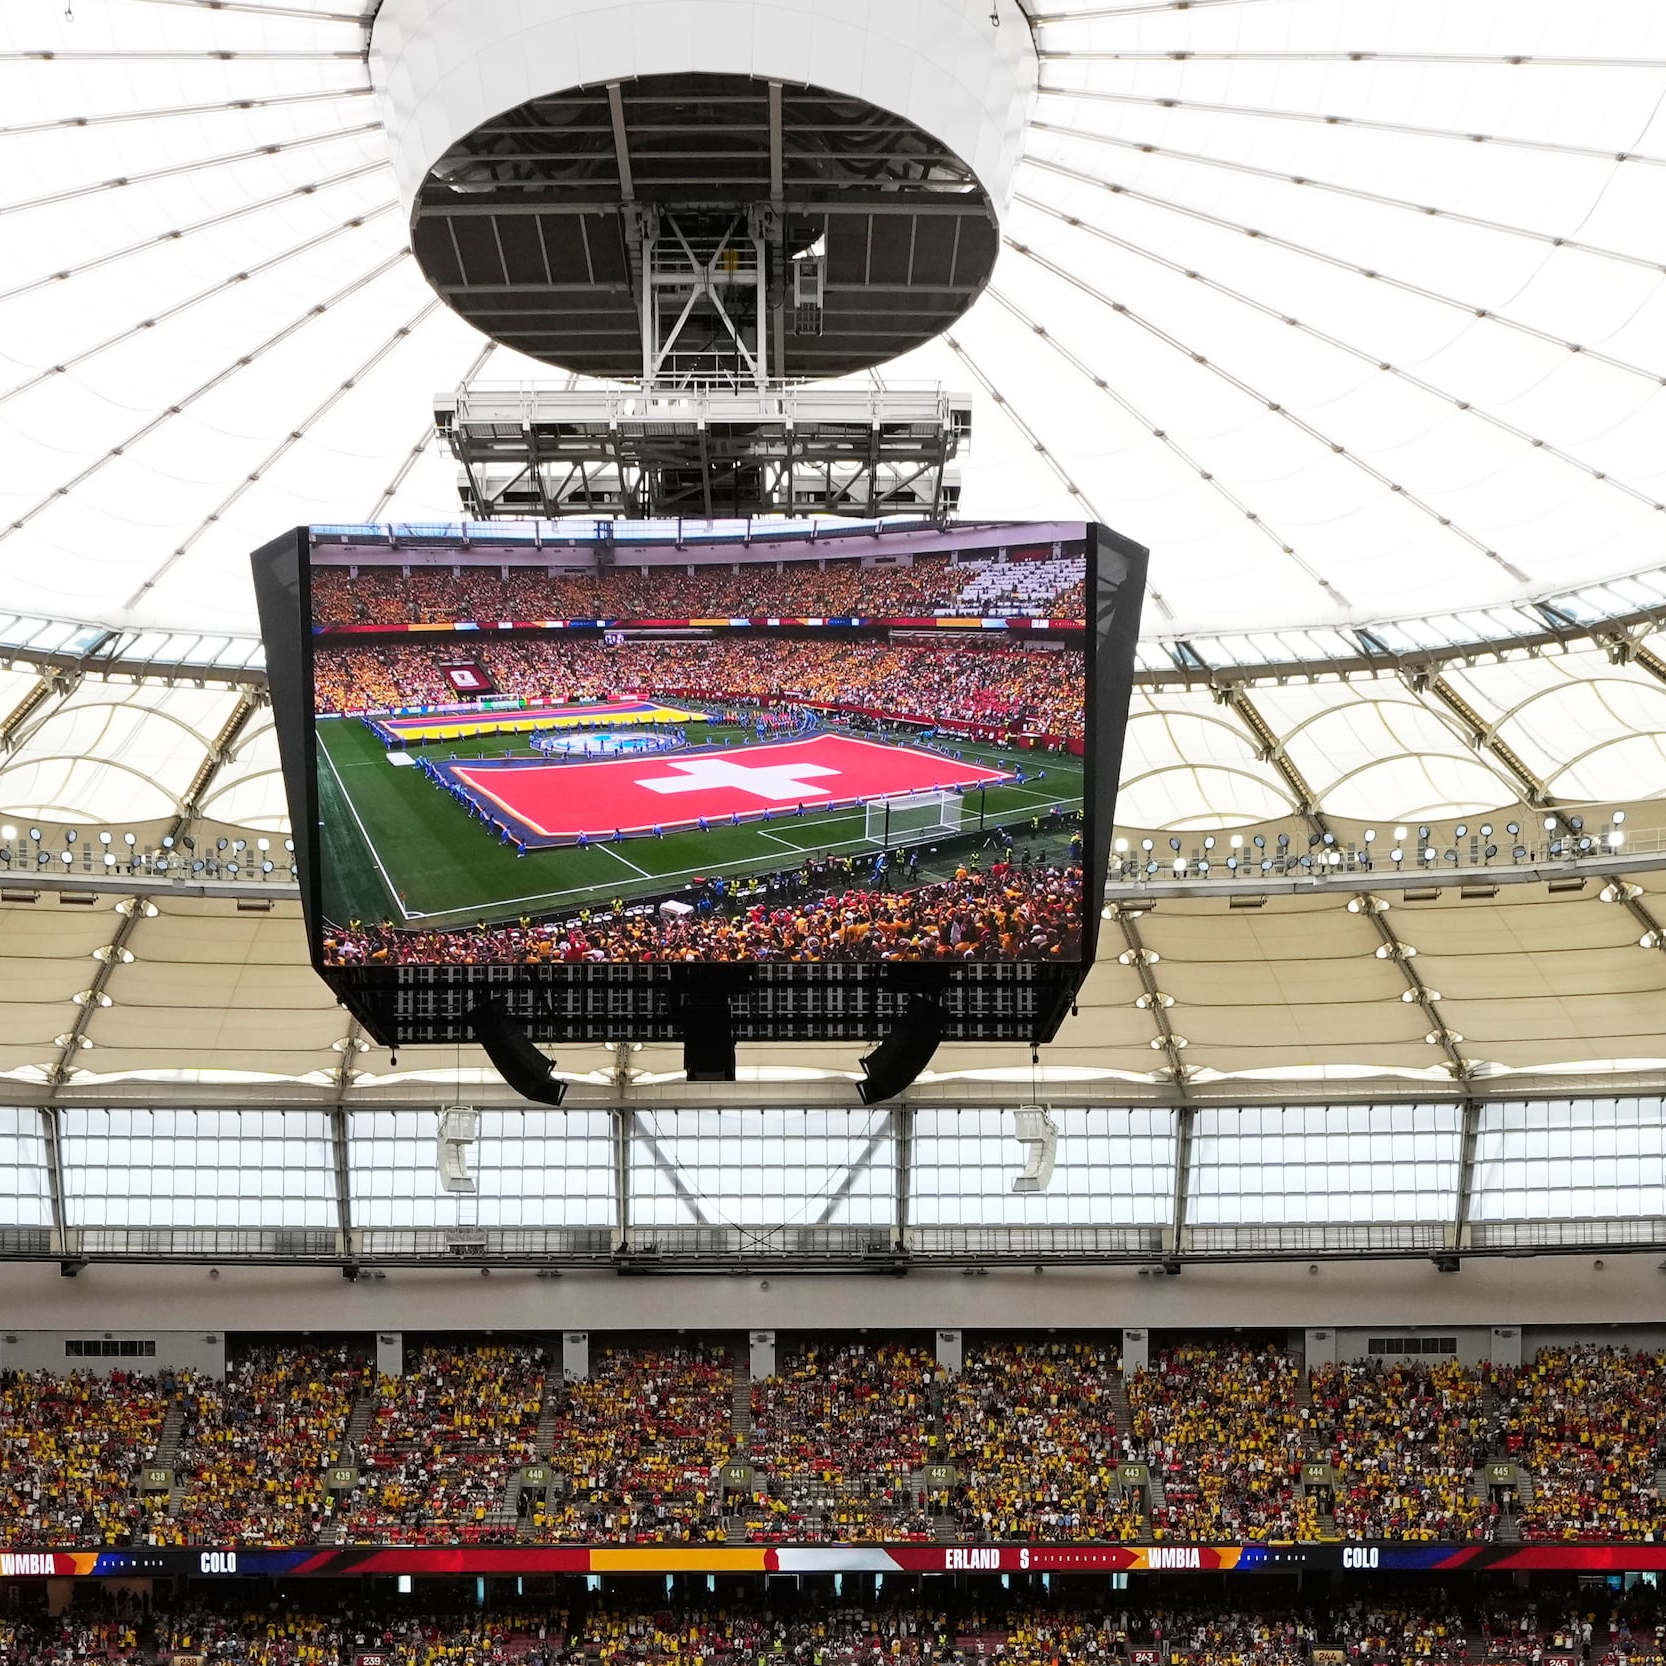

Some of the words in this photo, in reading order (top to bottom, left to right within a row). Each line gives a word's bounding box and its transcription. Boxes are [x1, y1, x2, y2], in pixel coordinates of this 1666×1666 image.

[200, 1552, 236, 1574] COLO
[945, 1548, 1000, 1569] ERLAND
[1343, 1547, 1378, 1568] COLO
